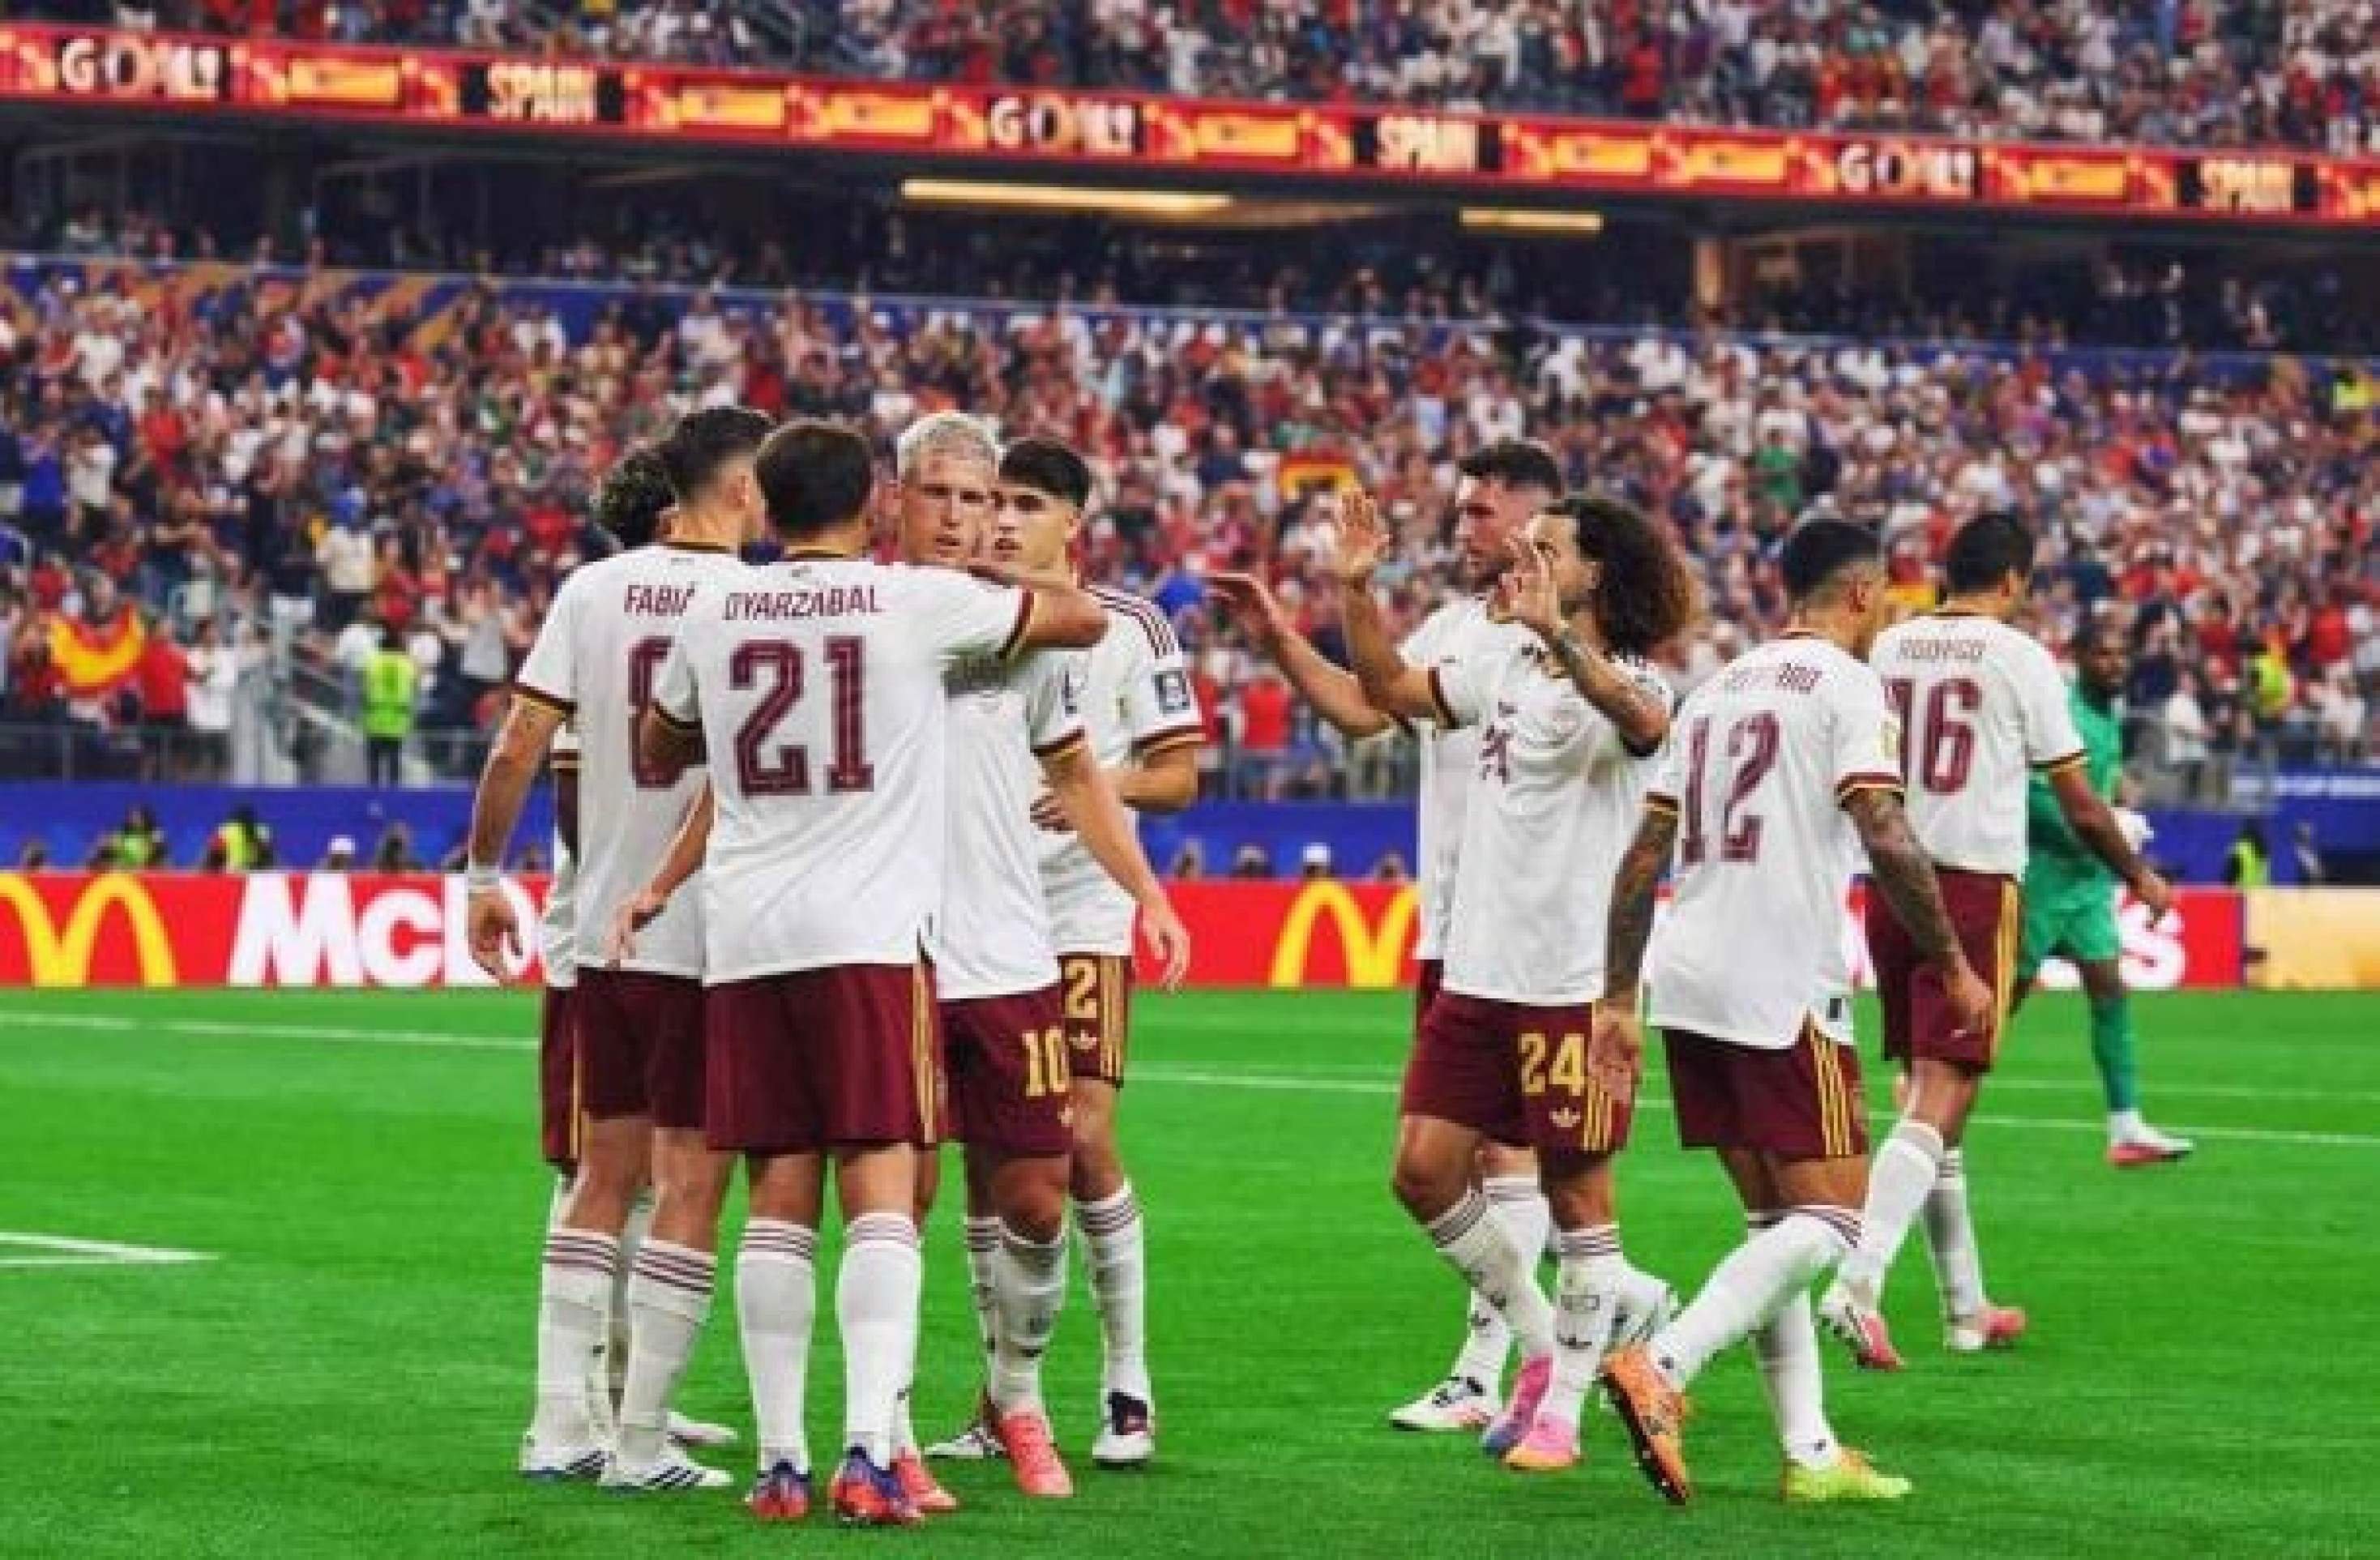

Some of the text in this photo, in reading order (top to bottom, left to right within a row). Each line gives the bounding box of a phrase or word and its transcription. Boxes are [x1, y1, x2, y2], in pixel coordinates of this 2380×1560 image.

[729, 636, 875, 796] 21
[1882, 675, 1982, 796] 16
[1681, 710, 1780, 863] 12
[1022, 1027, 1070, 1096] 10
[1520, 1032, 1584, 1096] 24
